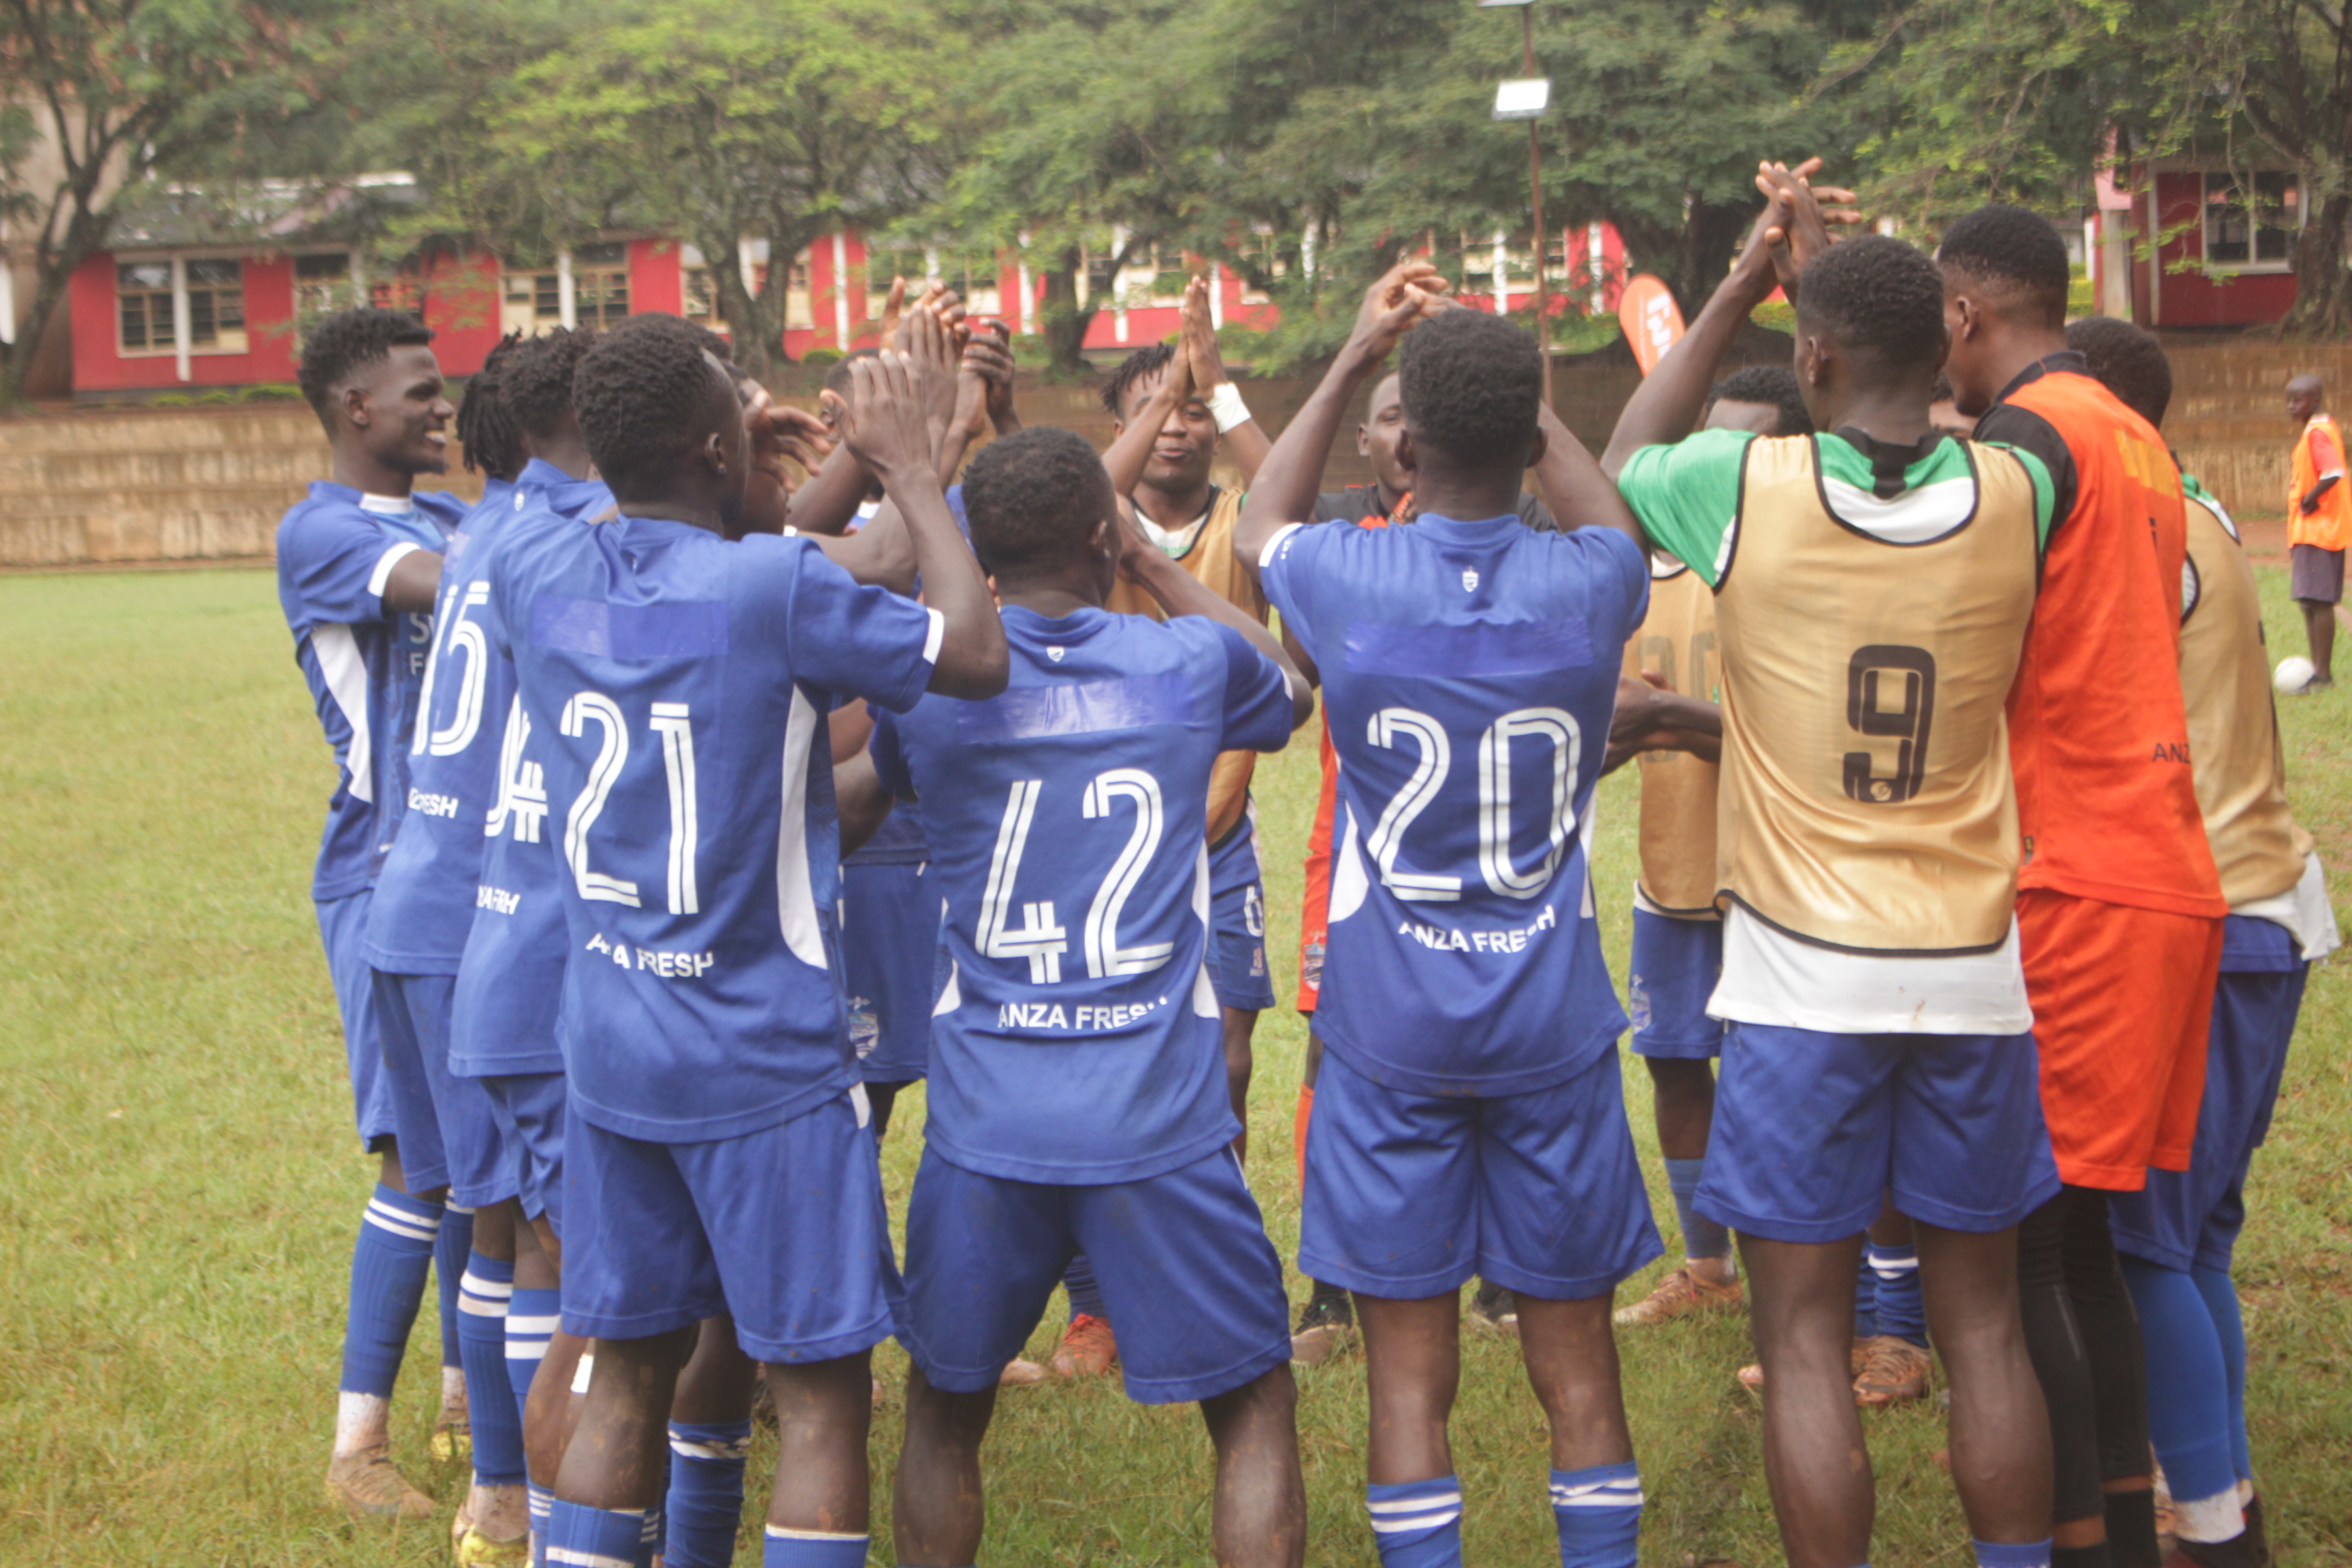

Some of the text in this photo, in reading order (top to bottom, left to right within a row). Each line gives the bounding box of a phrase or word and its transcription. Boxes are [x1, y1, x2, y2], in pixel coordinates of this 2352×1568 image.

[560, 690, 698, 915] 21
[1367, 707, 1581, 901] 20
[1842, 644, 1936, 803] 9
[975, 768, 1175, 984] 42
[1398, 921, 1471, 952] ANZA
[997, 1002, 1068, 1029] ANZA
